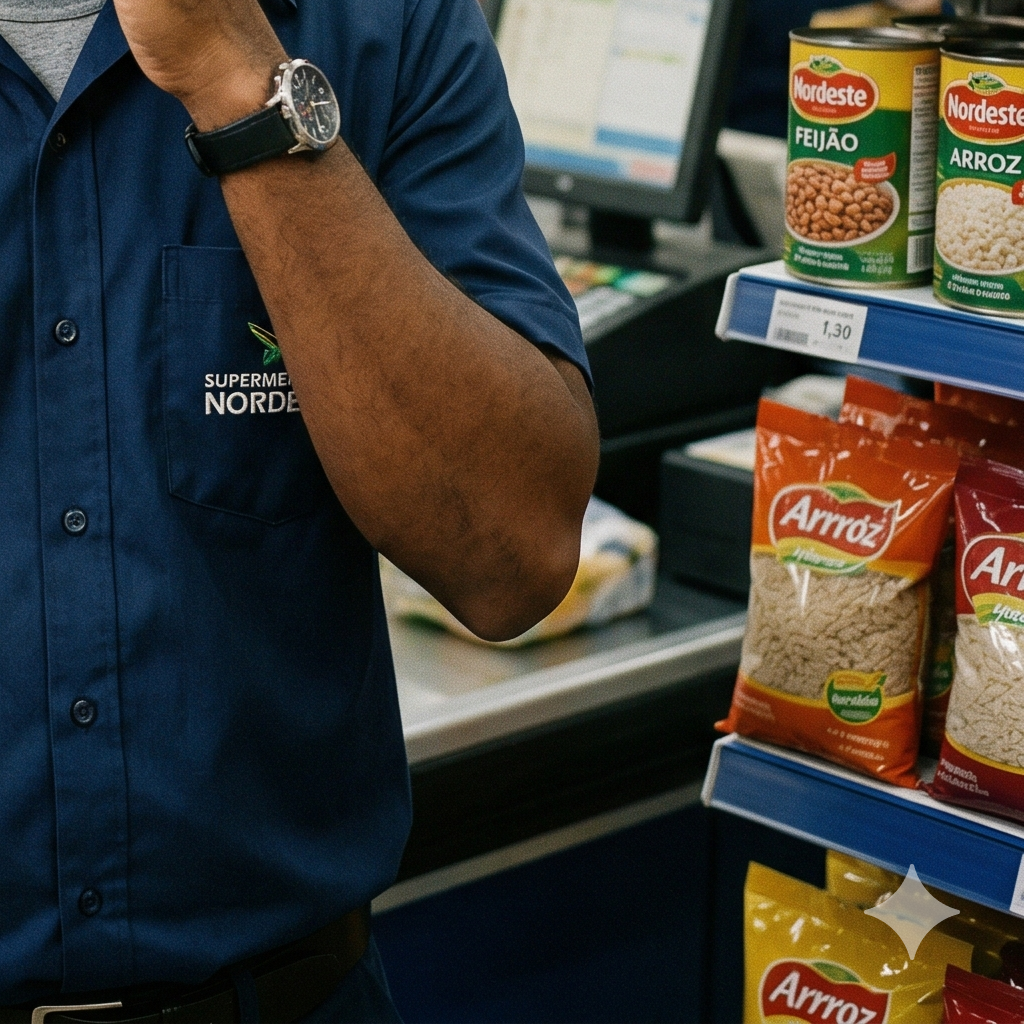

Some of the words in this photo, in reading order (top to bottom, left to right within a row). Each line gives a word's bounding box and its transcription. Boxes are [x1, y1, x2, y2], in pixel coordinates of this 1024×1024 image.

[794, 75, 868, 108] Nordeste
[948, 93, 1024, 127] Nordeste
[796, 126, 859, 153] FEIJÃO
[949, 147, 1023, 175] ARROZ
[204, 372, 291, 388] SUPERME
